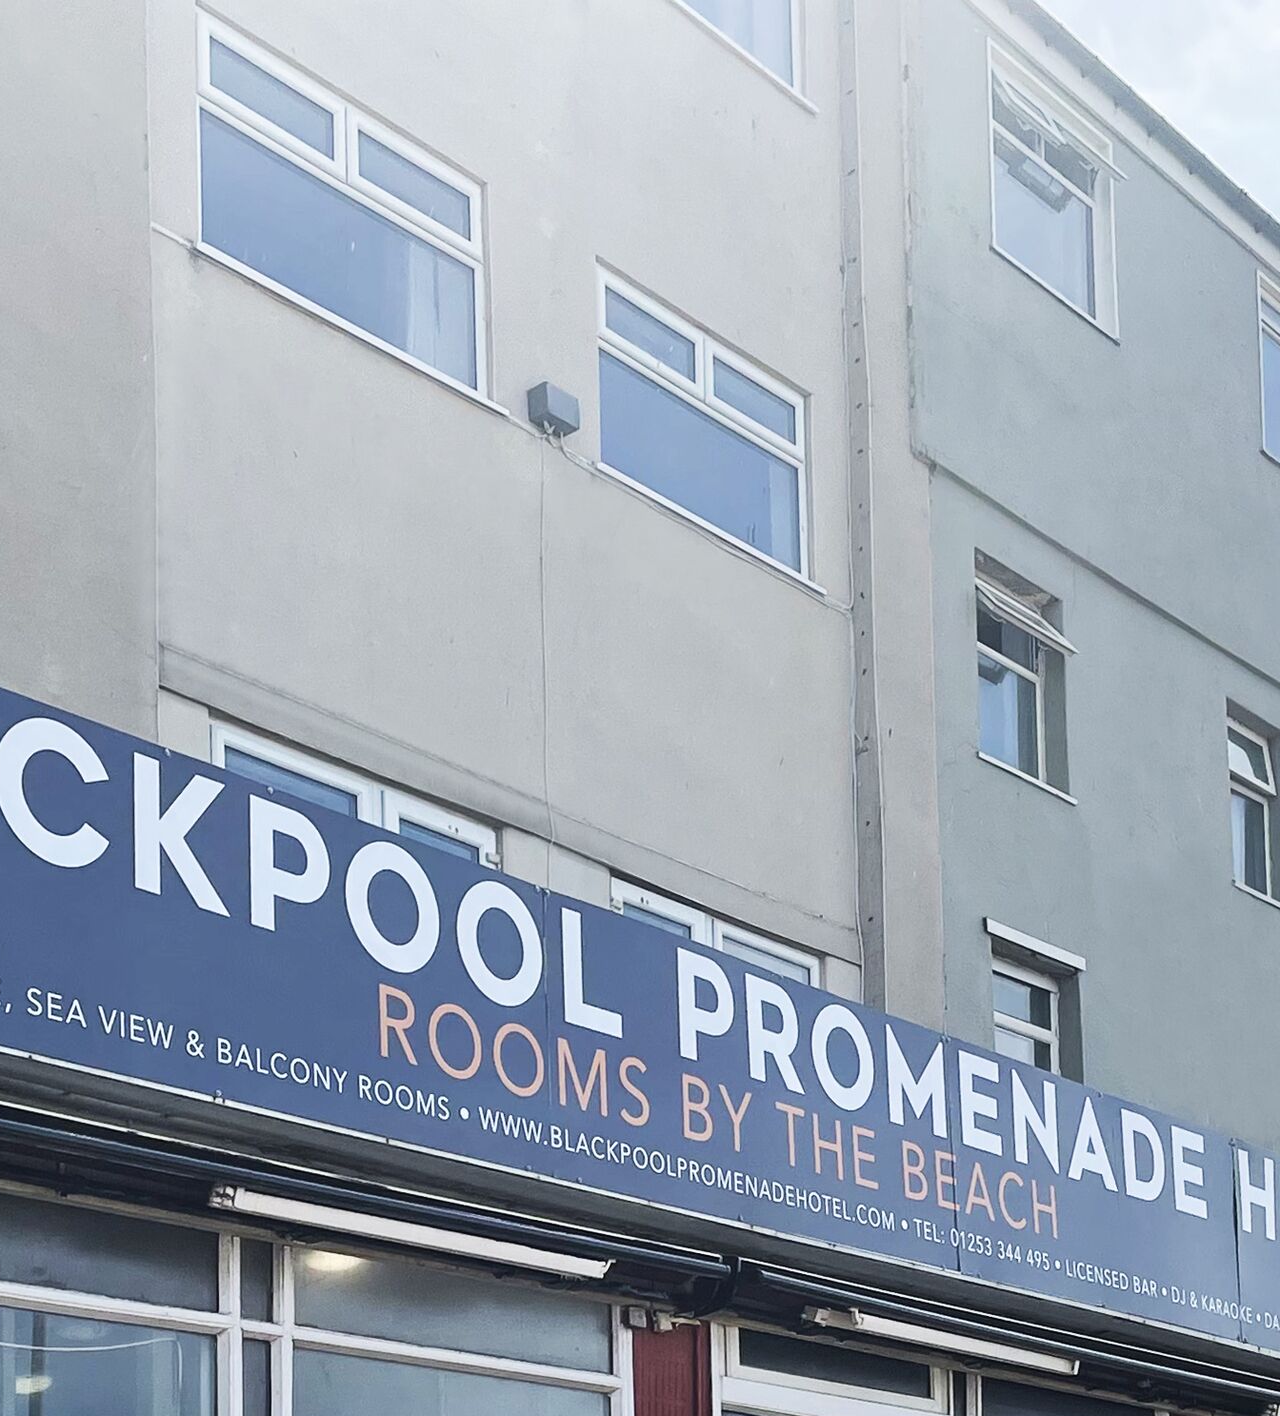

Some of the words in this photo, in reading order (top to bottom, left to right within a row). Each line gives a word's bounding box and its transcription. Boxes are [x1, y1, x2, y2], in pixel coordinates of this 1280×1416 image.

[26, 988, 87, 1029] SEA
[99, 1006, 174, 1050] VIEW
[186, 1029, 206, 1058] &
[217, 1038, 347, 1094] BALCONY
[358, 1074, 450, 1121] ROOMS
[479, 1106, 895, 1231] WWW.BLACKPOOLPROMENADEHOTEL.COM
[913, 1218, 945, 1245] TEL:
[950, 1228, 993, 1256] 01253
[998, 1240, 1022, 1264] 344
[1026, 1247, 1050, 1271] 495
[1065, 1259, 1129, 1290] LICENSED
[1133, 1275, 1158, 1298] BAR
[1171, 1285, 1186, 1306] DJ
[1190, 1291, 1198, 1308] &
[1201, 1294, 1253, 1324] KARAOKE
[377, 983, 651, 1127] ROOMS
[682, 1074, 753, 1153] BY
[775, 1101, 879, 1190] THE
[901, 1138, 1059, 1240] BEACH
[677, 947, 1208, 1220] PROMENADE
